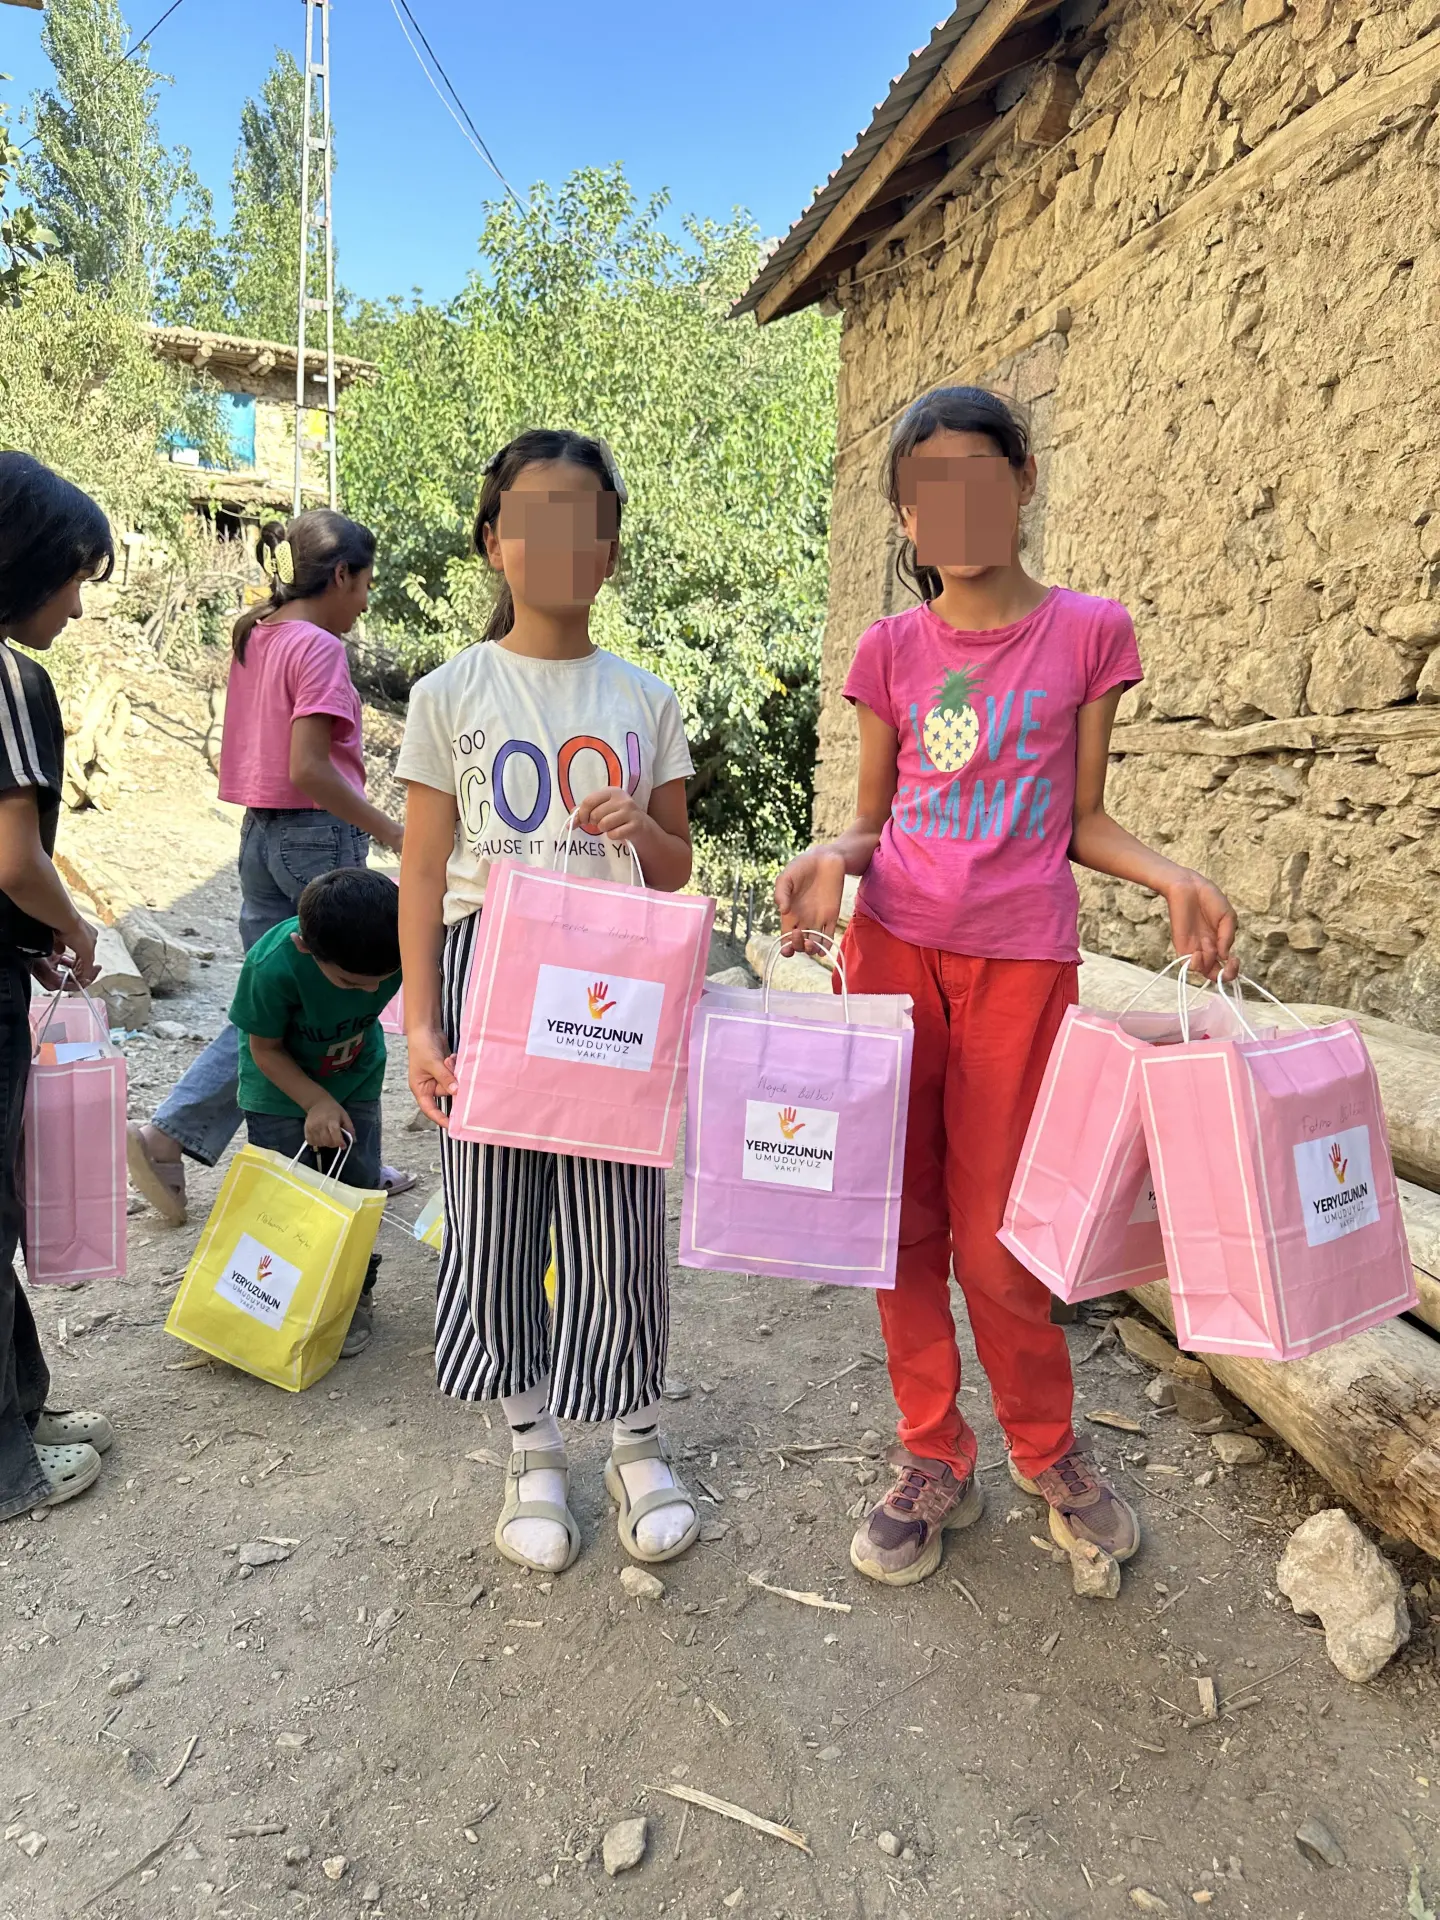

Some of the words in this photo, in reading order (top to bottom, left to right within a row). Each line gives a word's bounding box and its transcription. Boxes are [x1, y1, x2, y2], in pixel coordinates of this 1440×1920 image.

[529, 840, 544, 855] IT
[554, 840, 606, 857] MAKES
[556, 1036, 630, 1054] UMUDUYUZ
[577, 1049, 606, 1060] VAKFI
[755, 1153, 821, 1169] UMUDUYUZ
[774, 1164, 801, 1173] VAKFI
[232, 1284, 271, 1313] UMUDUYUZ
